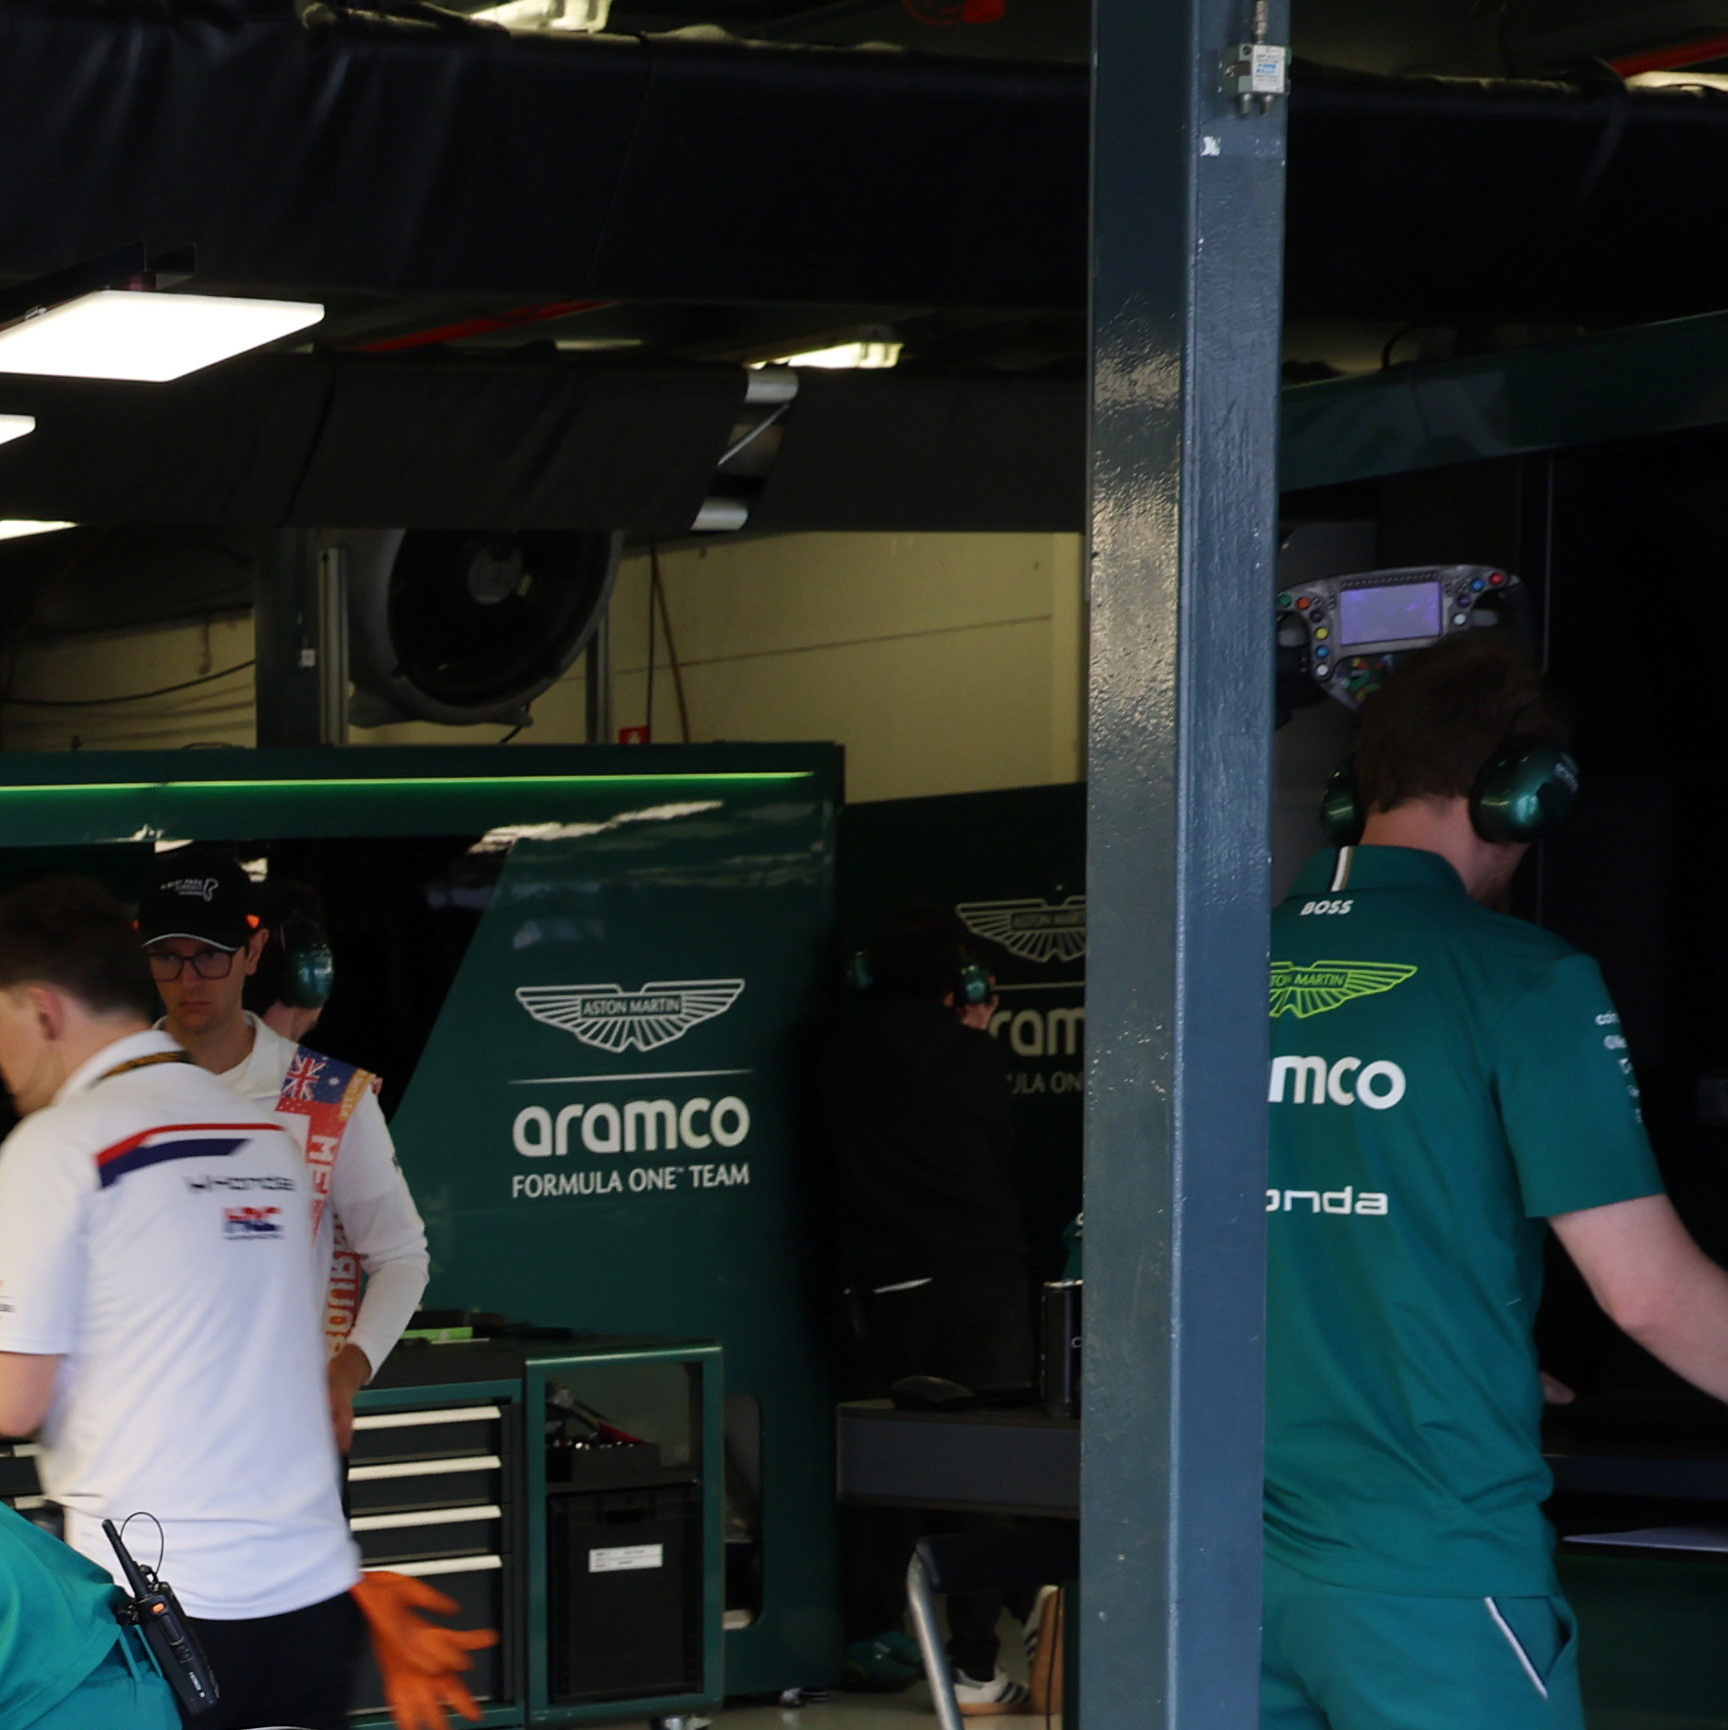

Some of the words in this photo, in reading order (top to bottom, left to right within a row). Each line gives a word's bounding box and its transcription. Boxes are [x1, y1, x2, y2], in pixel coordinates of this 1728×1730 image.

[1300, 900, 1354, 916] BOSS
[1295, 973, 1345, 988] MARTIN
[582, 1000, 627, 1016] ASTON
[629, 996, 681, 1013] MARTIN
[1267, 1055, 1407, 1110] mco
[511, 1096, 751, 1158] aramco
[512, 1169, 624, 1199] FORMULA
[688, 1163, 751, 1189] TEAM
